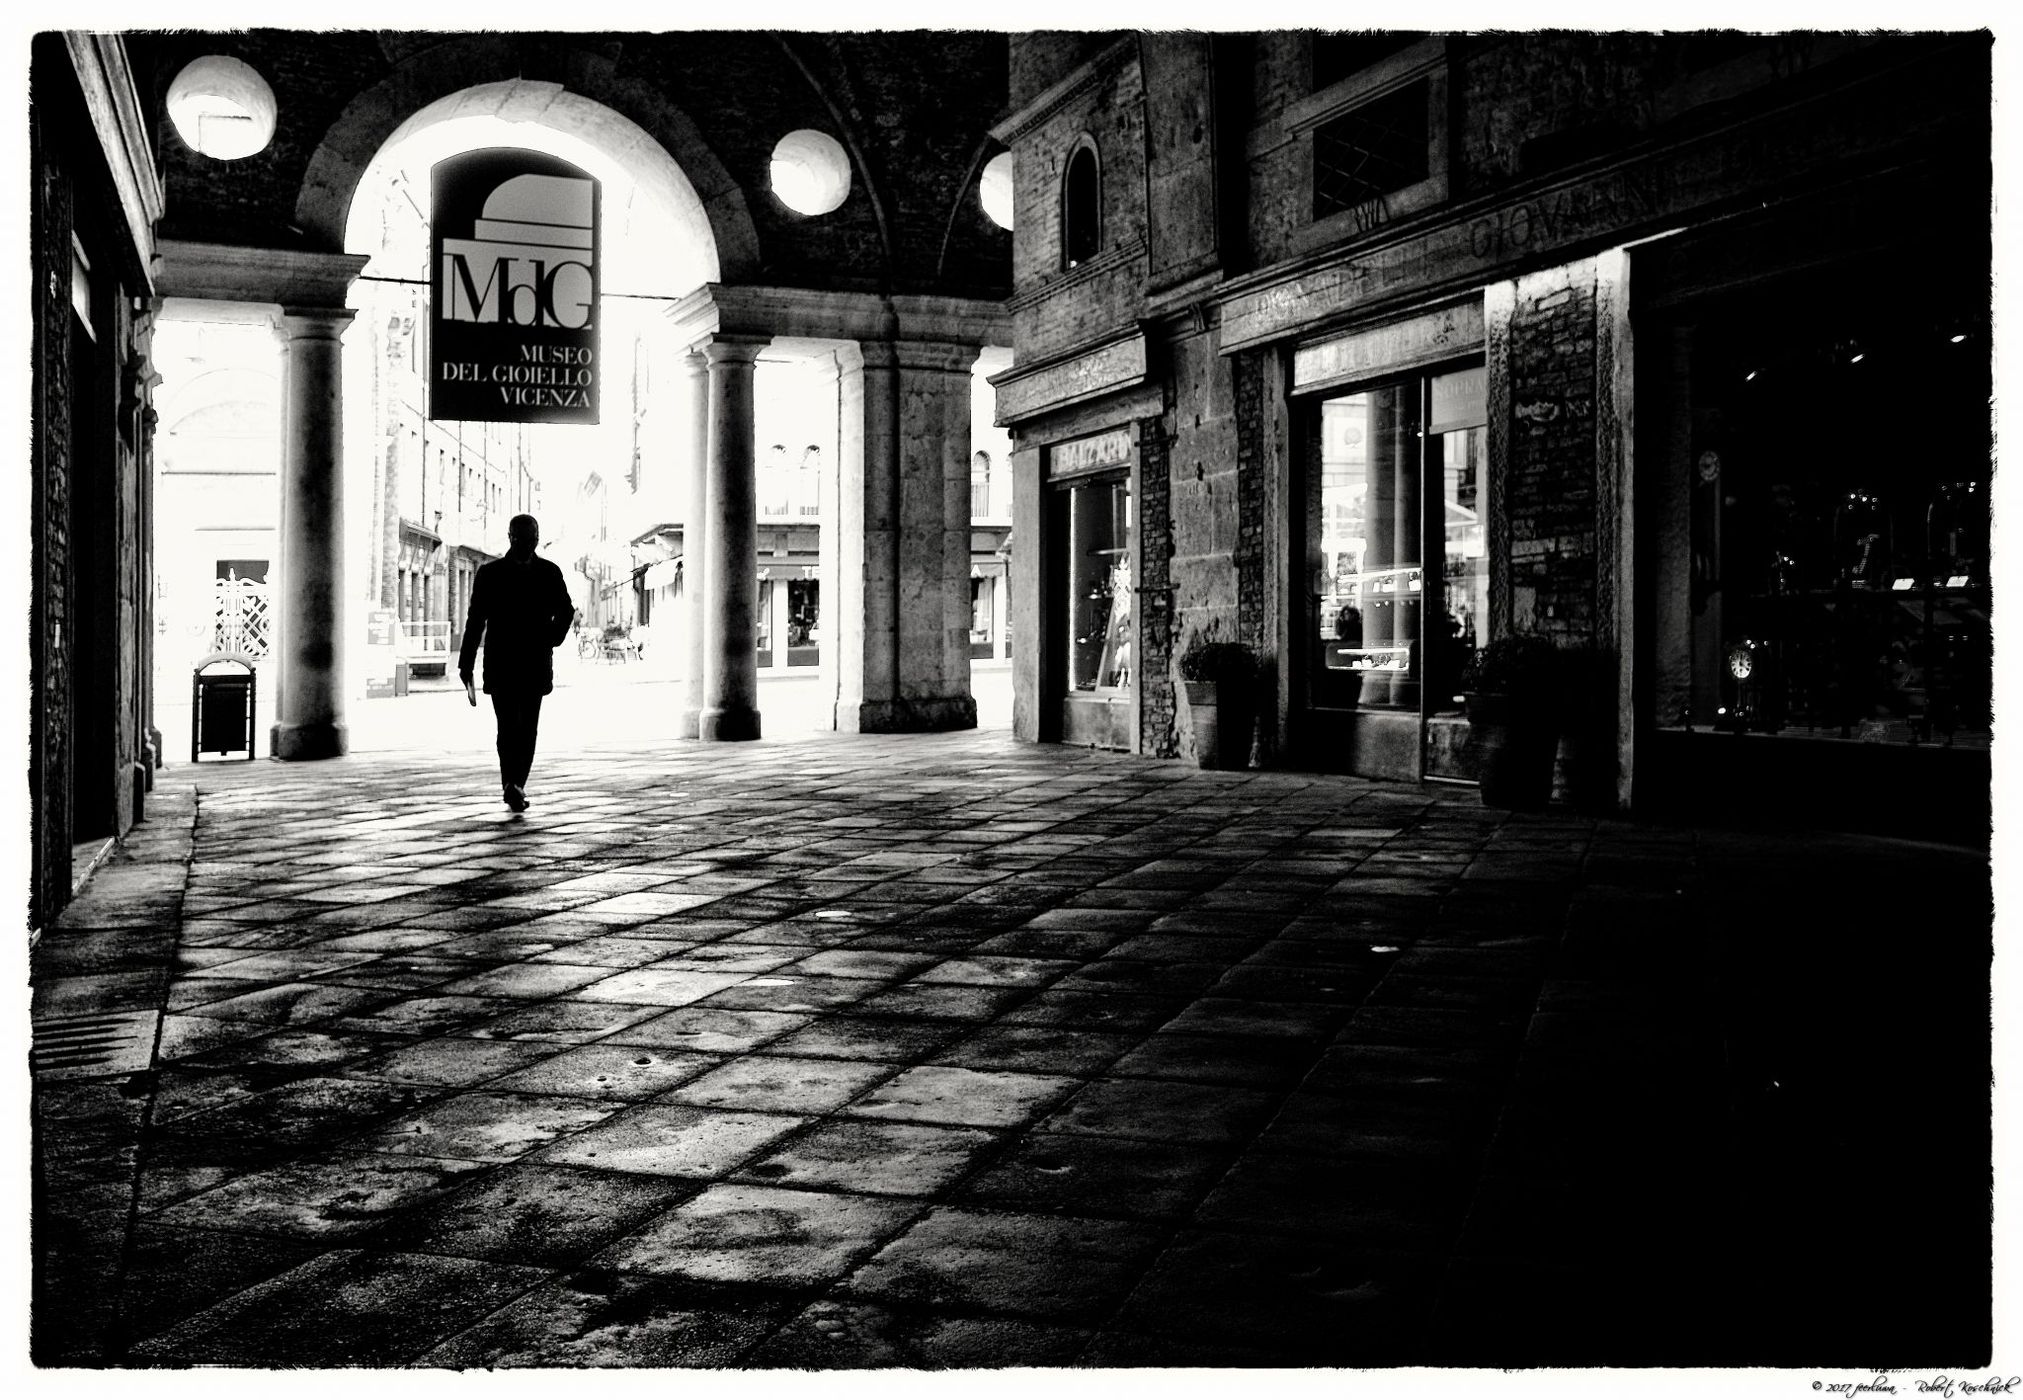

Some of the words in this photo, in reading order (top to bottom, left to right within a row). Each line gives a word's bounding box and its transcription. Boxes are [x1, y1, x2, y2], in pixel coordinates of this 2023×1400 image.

[443, 254, 593, 329] MdG
[520, 344, 593, 364] MUSEO
[442, 361, 488, 383] DEL
[492, 365, 593, 386] GIOIELLO
[500, 386, 591, 408] VICENZA
